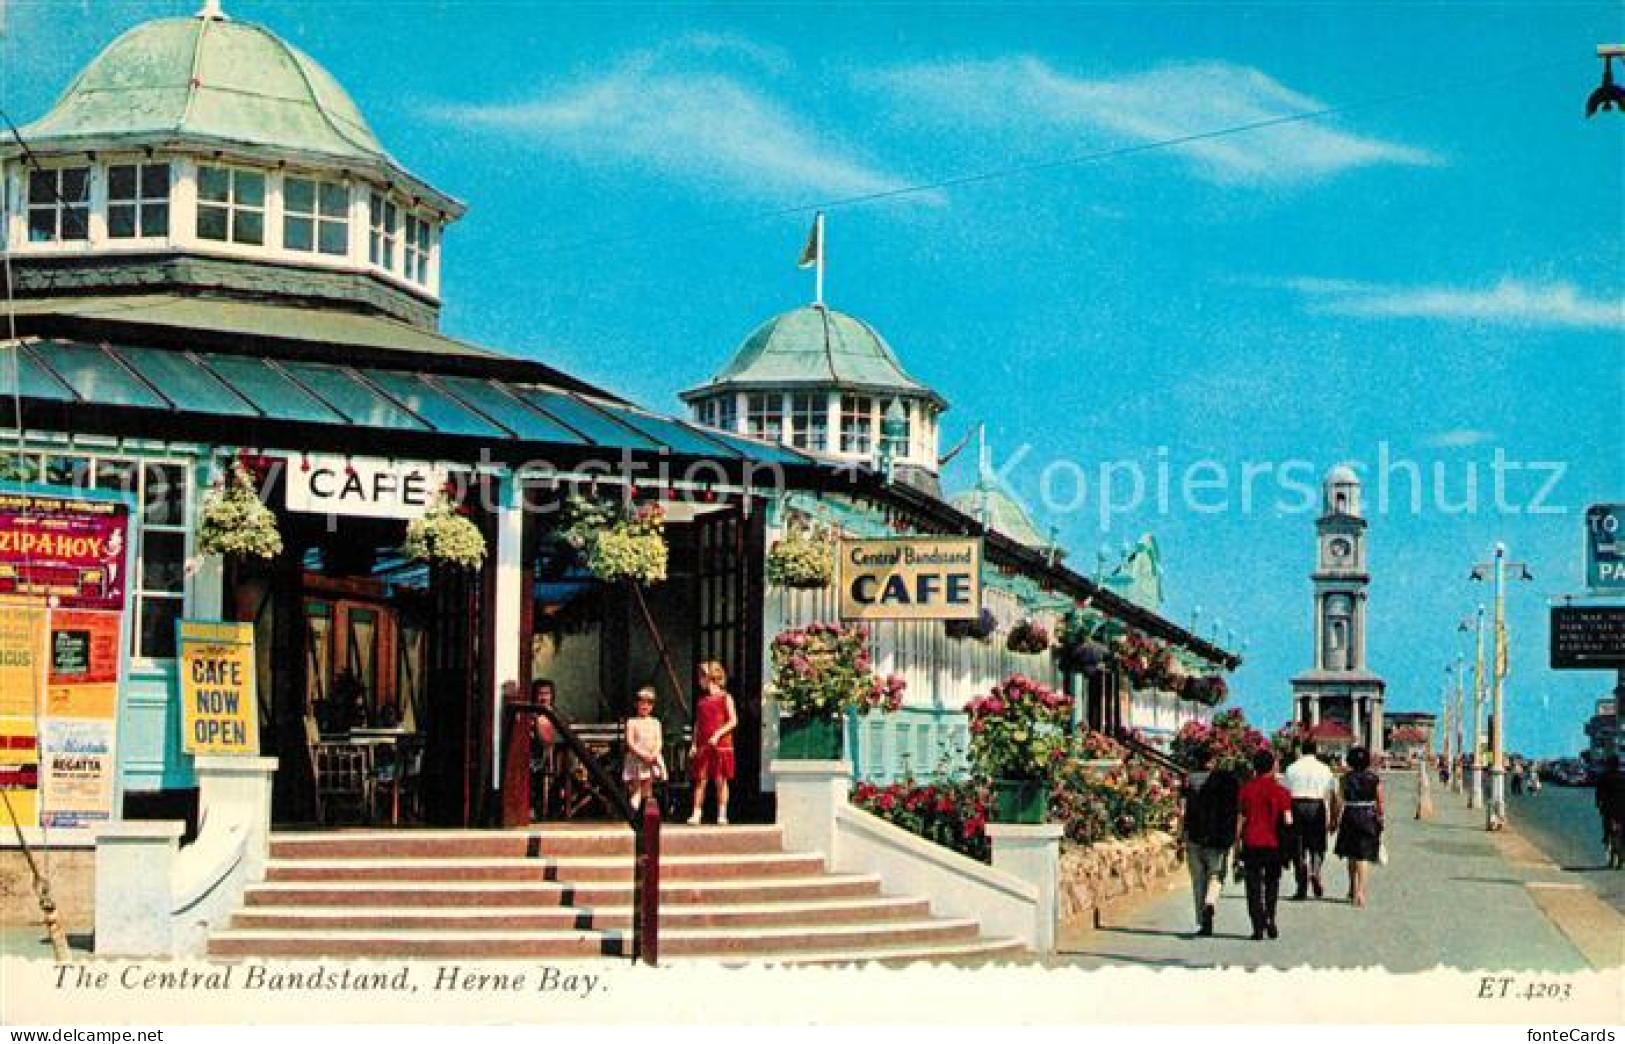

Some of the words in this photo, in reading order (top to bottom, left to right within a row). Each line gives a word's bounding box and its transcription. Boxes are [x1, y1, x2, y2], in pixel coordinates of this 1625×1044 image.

[309, 469, 427, 506] CAFÉ
[1590, 514, 1619, 534] TO
[851, 545, 900, 565] Central
[905, 545, 971, 565] Bandstand
[851, 572, 970, 604] CAFE
[192, 658, 243, 686] CAFE
[196, 689, 240, 715] NOW
[194, 719, 247, 746] OPEN
